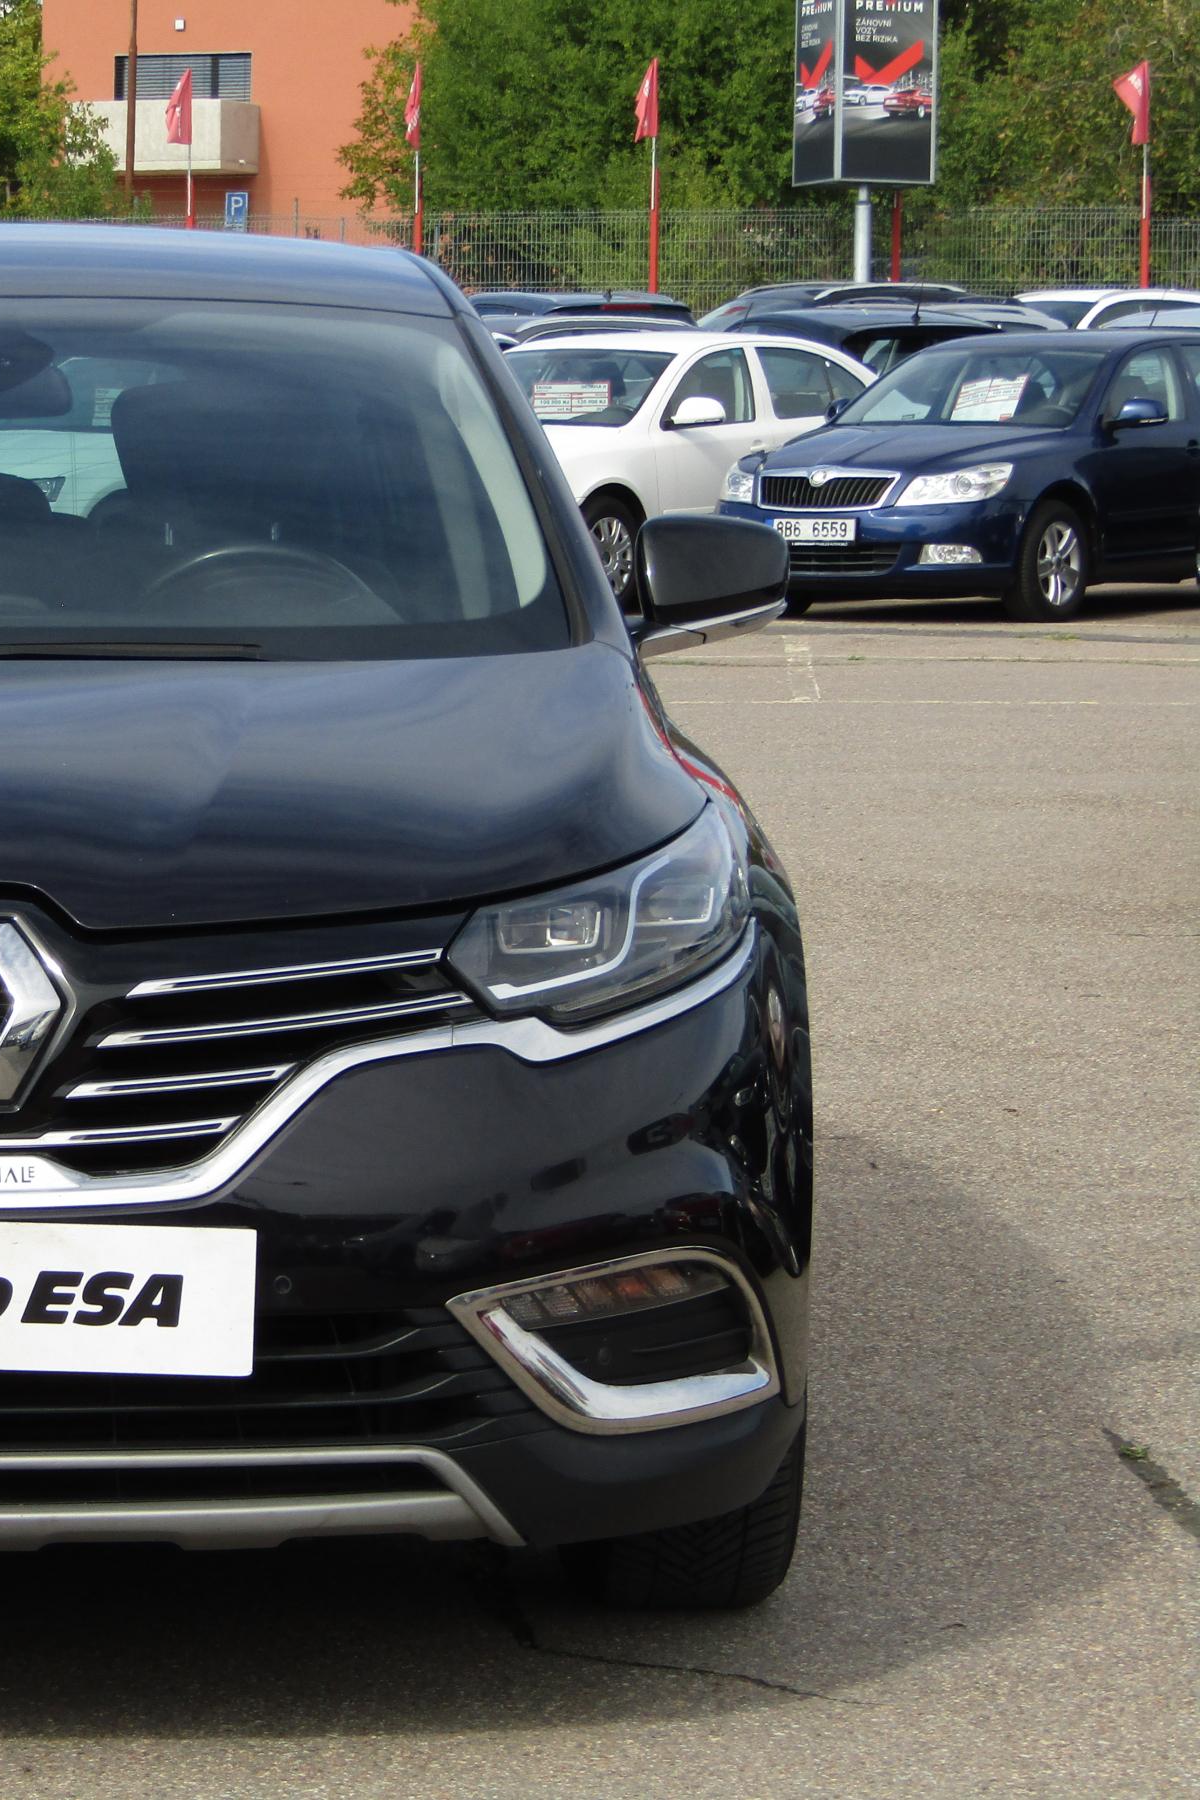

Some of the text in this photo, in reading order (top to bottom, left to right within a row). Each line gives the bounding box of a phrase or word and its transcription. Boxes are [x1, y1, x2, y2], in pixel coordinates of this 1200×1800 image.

[855, 0, 924, 13] PREMIUM
[855, 34, 898, 43] BEZ RIZIKA
[231, 196, 243, 216] P
[812, 521, 848, 538] 6559
[20, 1270, 184, 1328] ESA
